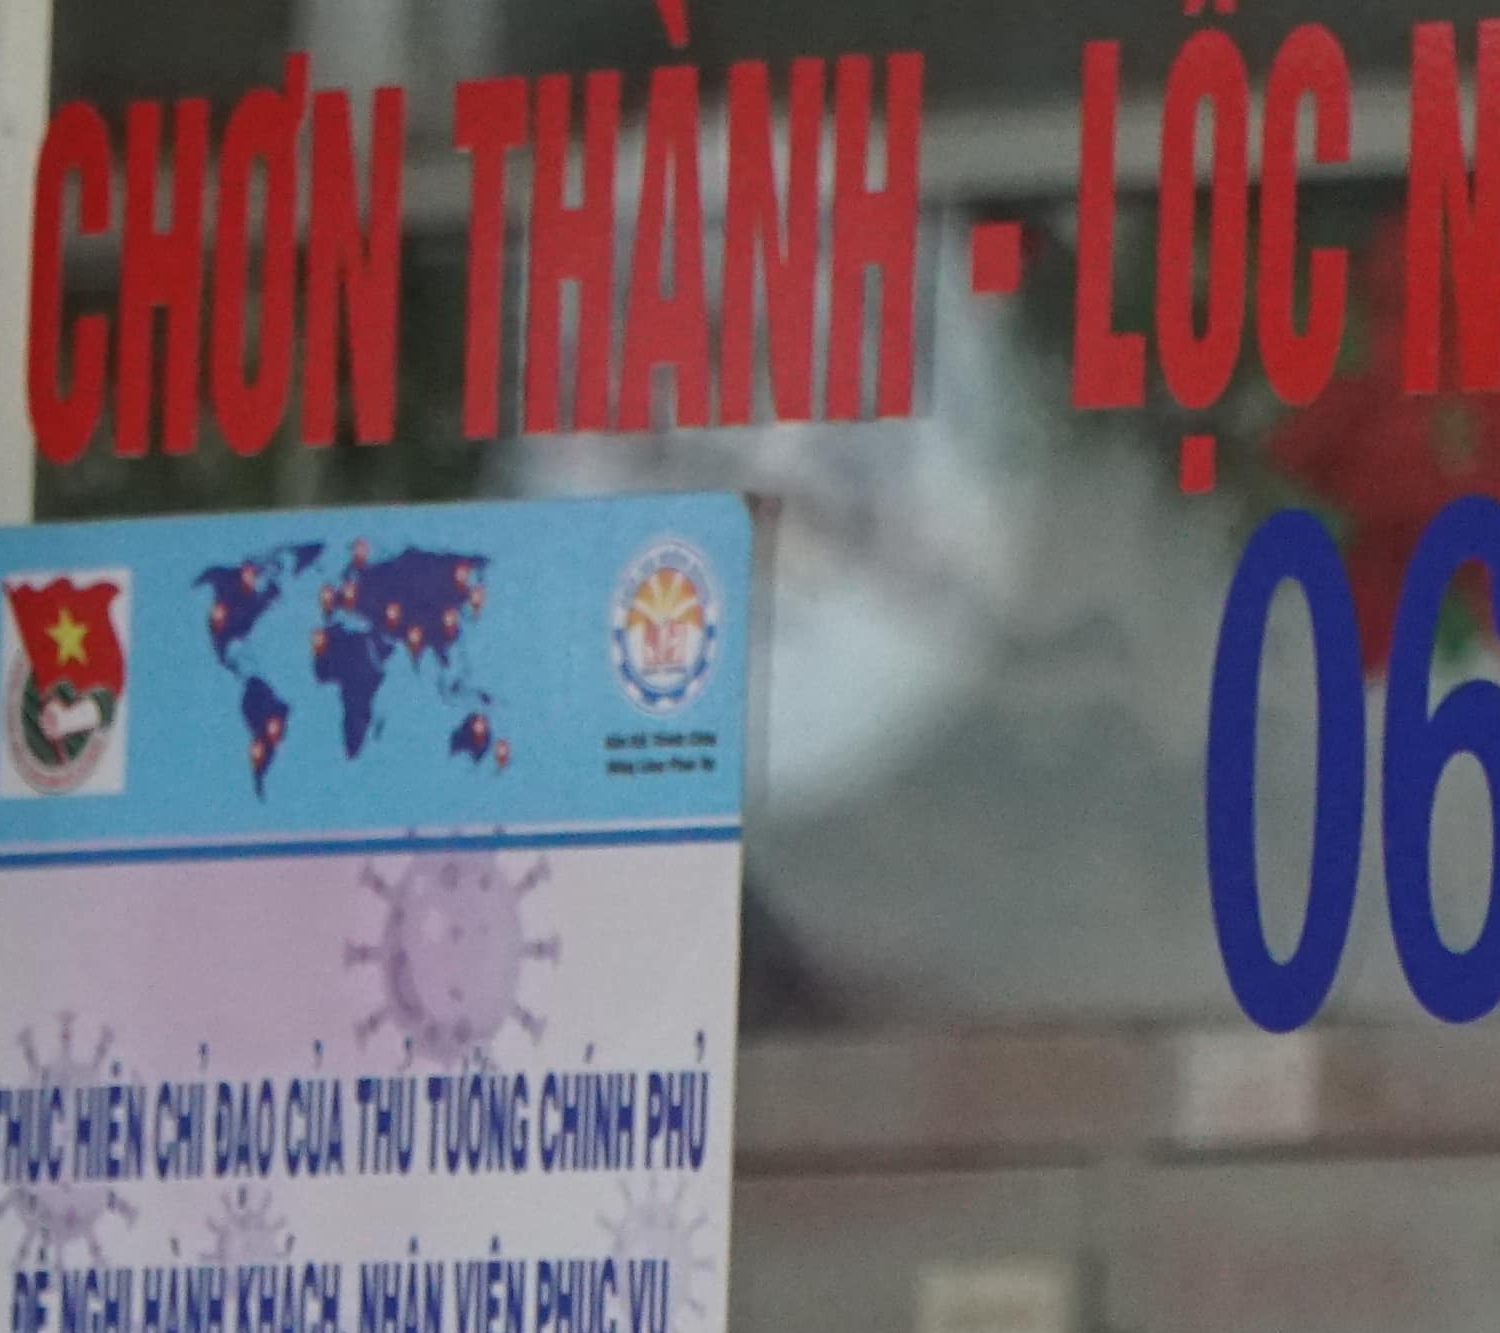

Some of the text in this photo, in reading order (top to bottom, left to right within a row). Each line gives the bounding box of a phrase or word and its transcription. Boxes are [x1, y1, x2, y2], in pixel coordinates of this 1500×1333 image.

[26, 52, 405, 465] CHƠN
[453, 0, 925, 441] THÀNH
[74, 1060, 146, 1210] HIỆN
[154, 1042, 209, 1177] CHỈ
[214, 1079, 274, 1207] ĐẠO
[287, 1040, 345, 1175] CỦA
[357, 1038, 418, 1175] THỦ
[540, 1042, 636, 1173] CHÍNH
[645, 1030, 709, 1172] PHỦ
